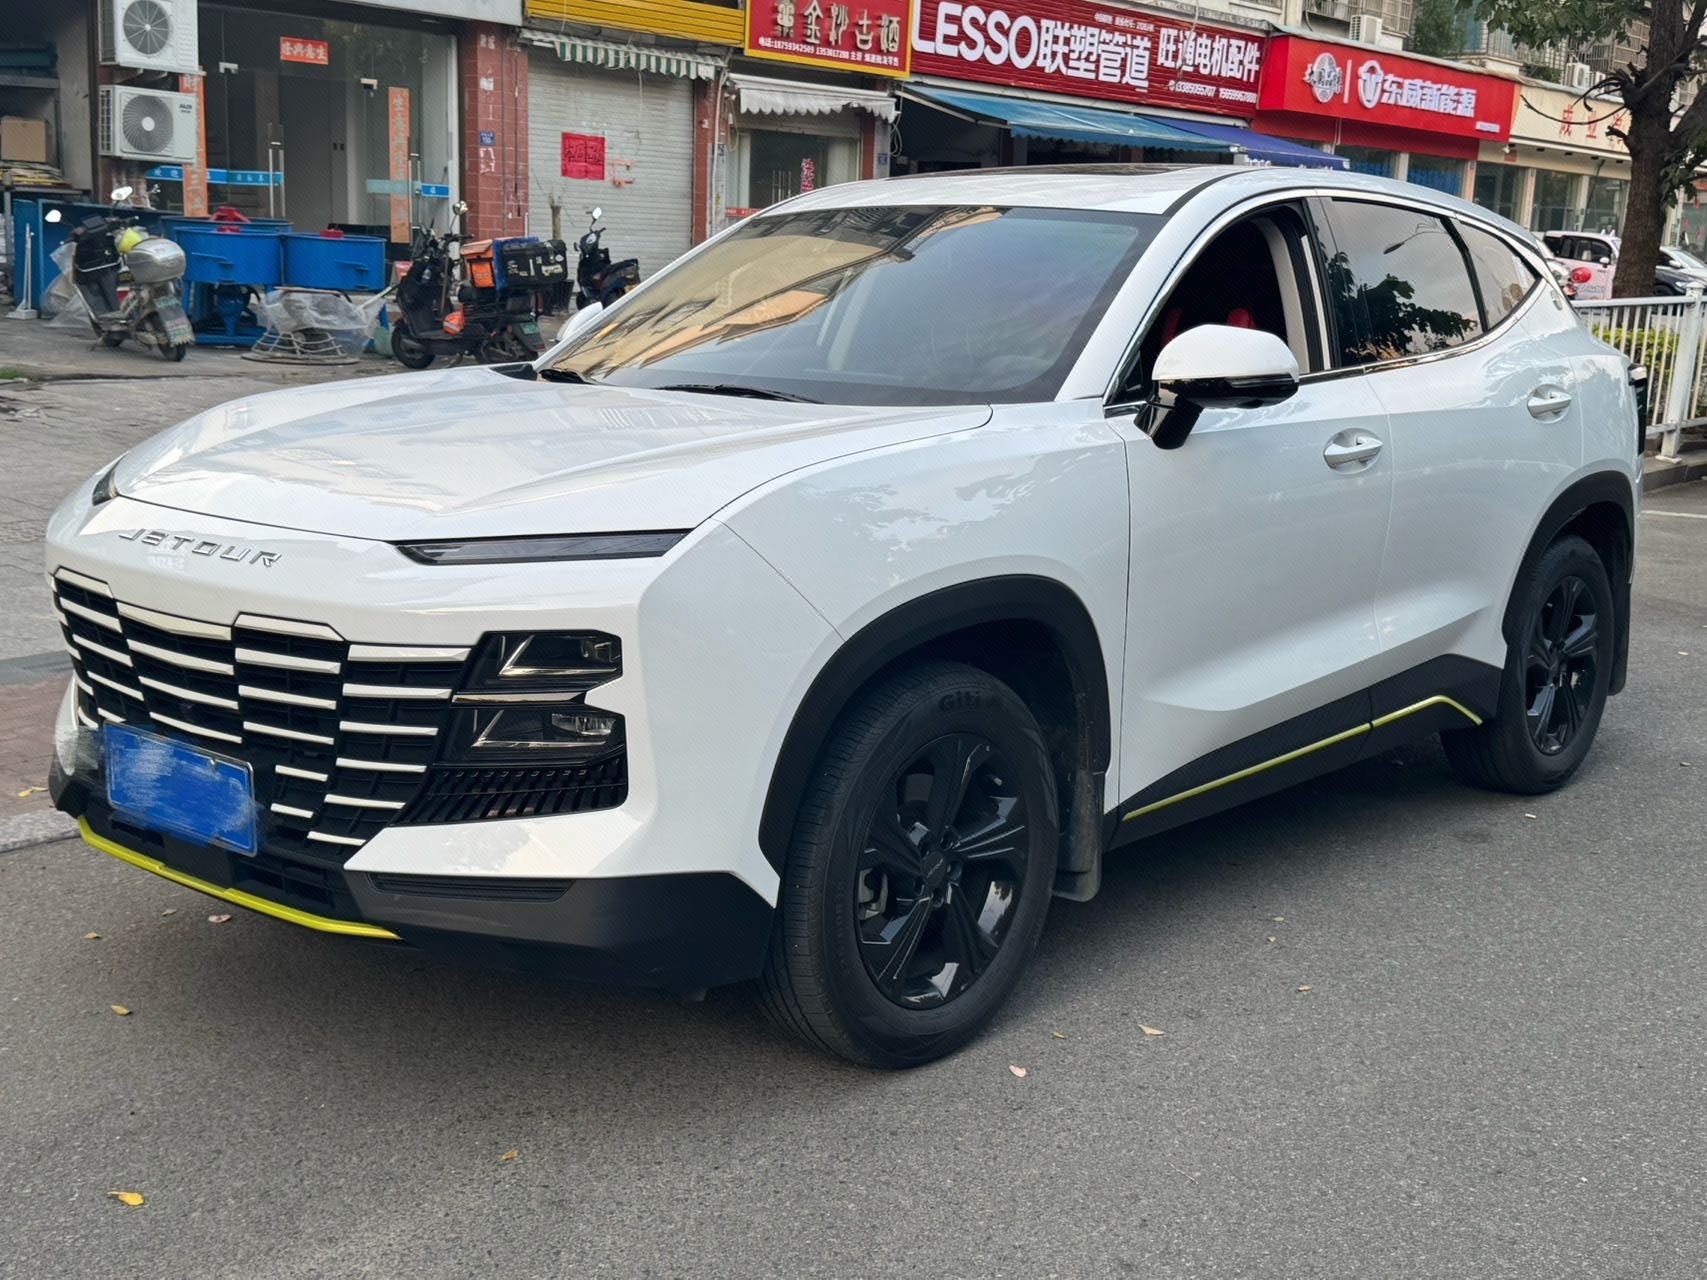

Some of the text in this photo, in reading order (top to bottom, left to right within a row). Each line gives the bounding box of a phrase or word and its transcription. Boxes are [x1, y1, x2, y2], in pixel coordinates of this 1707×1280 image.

[911, 0, 1151, 88] LESSO 联塑管道
[1157, 27, 1261, 82] 旺通电机配件
[118, 528, 282, 568] JETOUR
